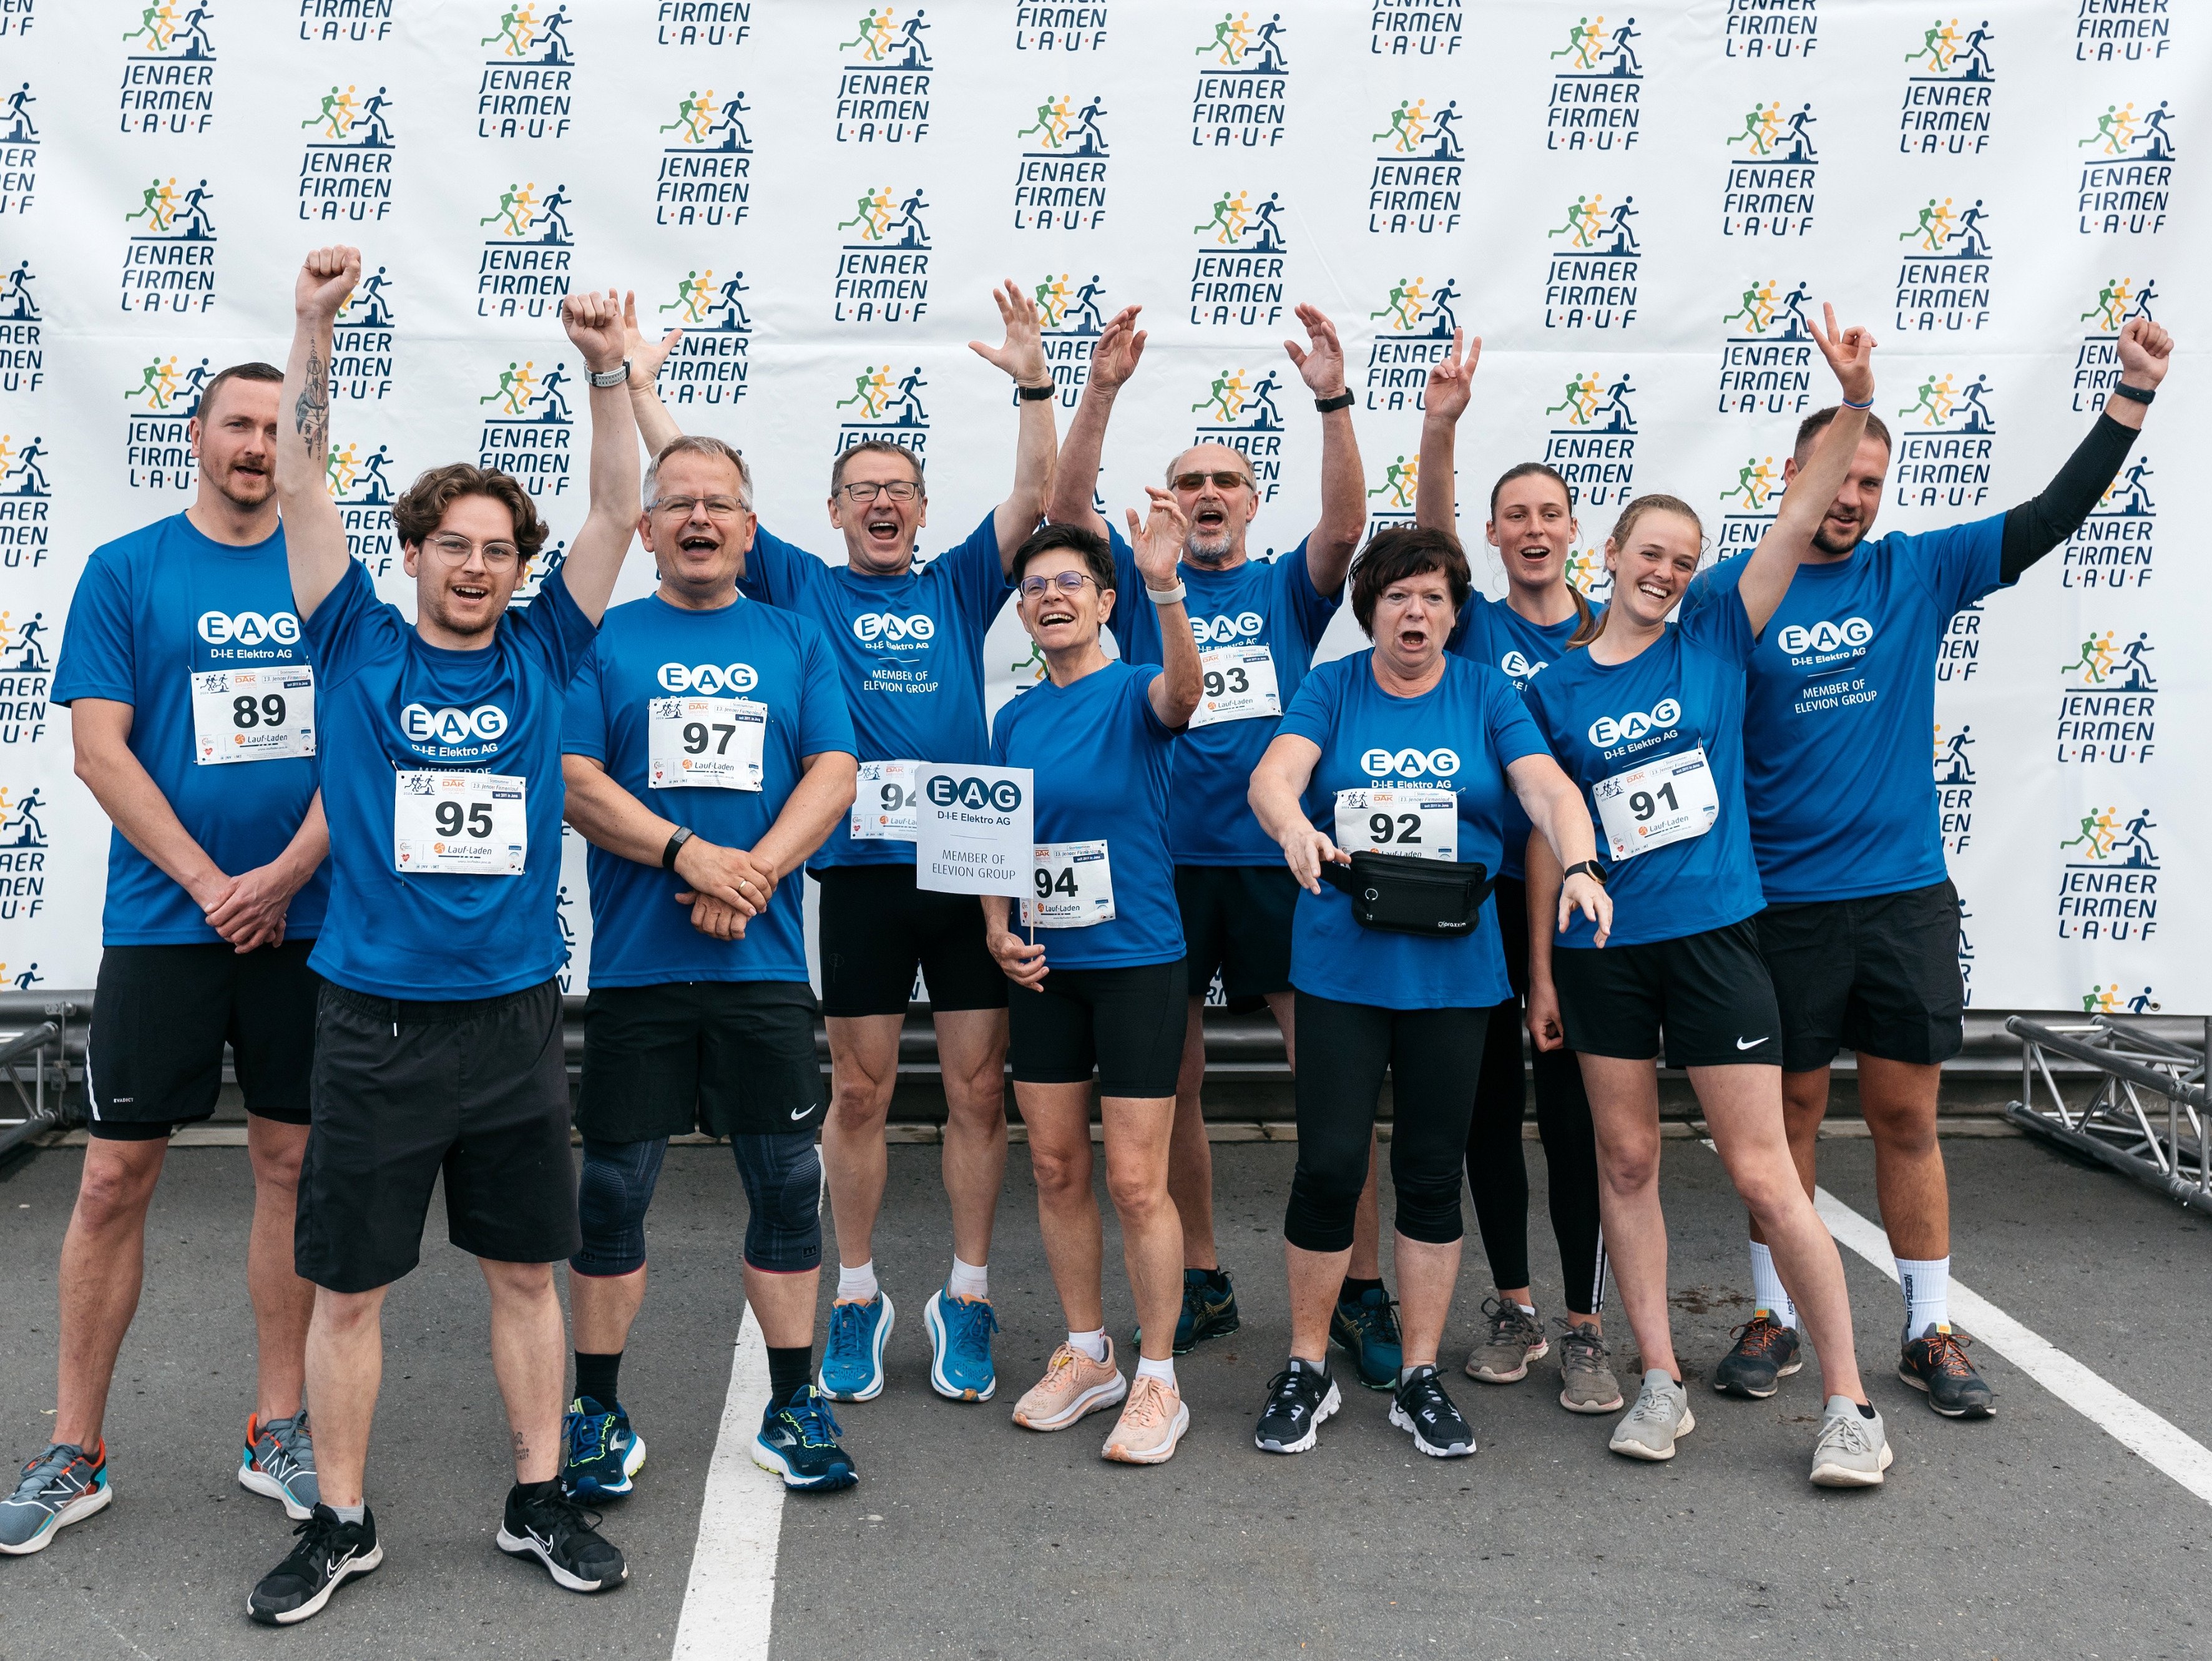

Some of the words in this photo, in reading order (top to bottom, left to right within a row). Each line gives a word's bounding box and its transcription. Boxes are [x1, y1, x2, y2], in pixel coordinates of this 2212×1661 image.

[300, 0, 393, 18] FIRMEN
[658, 2, 751, 22] FIRMEN
[1016, 7, 1107, 29] FIRMEN
[1371, 11, 1462, 32] FIRMEN
[1726, 15, 1818, 35] FIRMEN
[2077, 18, 2169, 38] FIRMEN
[120, 65, 213, 89] JENAER
[478, 70, 571, 94] JENAER
[837, 75, 930, 99] JENAER
[120, 90, 213, 110] FIRMEN
[1193, 79, 1285, 103] JENAER
[1548, 83, 1640, 107] JENAER
[1902, 86, 1992, 110] JENAER
[478, 95, 571, 115] FIRMEN
[836, 99, 929, 120] FIRMEN
[1193, 104, 1285, 124] FIRMEN
[1548, 108, 1640, 127] FIRMEN
[1901, 110, 1990, 131] FIRMEN
[300, 152, 392, 177] JENAER
[657, 157, 750, 182] JENAER
[1015, 162, 1107, 186] JENAER
[299, 177, 392, 198] FIRMEN
[1369, 166, 1462, 190] JENAER
[1725, 169, 1815, 193] JENAER
[2078, 166, 2171, 193] JENAER
[657, 182, 750, 203] FIRMEN
[1015, 187, 1106, 207] FIRMEN
[1369, 190, 1461, 210] FIRMEN
[2079, 191, 2169, 212] FIRMEN
[1723, 194, 1814, 213] FIRMEN
[123, 245, 214, 268] JENAER
[835, 254, 928, 278] JENAER
[122, 270, 215, 290] FIRMEN
[1191, 258, 1283, 282] JENAER
[1546, 261, 1638, 285] JENAER
[1896, 265, 1989, 288] JENAER
[835, 279, 928, 299] FIRMEN
[1191, 282, 1283, 303] FIRMEN
[1545, 286, 1637, 306] FIRMEN
[1896, 289, 1989, 308] FIRMEN
[1720, 346, 1811, 370] JENAER
[1720, 371, 1810, 391] FIRMEN
[1897, 439, 1992, 464] JENAER
[1897, 464, 1990, 484] FIRMEN
[2063, 546, 2153, 566] FIRMEN
[205, 615, 297, 640] EAG
[859, 615, 931, 638] EAG
[1190, 614, 1261, 640] EAG
[1784, 620, 1869, 651] EAG
[210, 649, 234, 659] D-I-E
[237, 649, 275, 659] Elektro
[276, 649, 292, 659] AG
[865, 641, 884, 650] D-I-E
[886, 640, 914, 650] Elektro
[1791, 657, 1813, 666] D-I-E
[1816, 652, 1849, 664] Elektro
[1852, 647, 1866, 657] AG
[664, 666, 753, 690] EAG
[872, 670, 913, 681] MEMBER
[915, 671, 927, 681] OF
[1204, 667, 1250, 697] 93
[864, 680, 903, 692] ELEVION
[906, 682, 938, 693] GROUP
[1803, 682, 1849, 698] MEMBER
[1852, 679, 1865, 690] OF
[233, 694, 286, 728] 89
[1218, 698, 1253, 708] Lauf-Laden
[1794, 697, 1838, 714] ELEVION
[1841, 690, 1877, 705] GROUP
[2058, 697, 2155, 720] JENAER
[407, 708, 502, 738] EAG
[1593, 701, 1676, 745] EAG
[2057, 721, 2155, 741] FIRMEN
[248, 734, 288, 743] Lauf-Laden
[683, 722, 736, 755] 97
[1603, 747, 1626, 760] D-I-E
[1627, 737, 1661, 753] Elektro
[1663, 730, 1678, 741] AG
[411, 743, 436, 755] D-I-E
[439, 746, 478, 757] Elektro
[481, 743, 498, 753] AG
[695, 762, 734, 771] Lauf-Laden
[1368, 752, 1456, 773] EAG
[932, 778, 1017, 810] EAG
[1371, 780, 1394, 788] D-I-E
[1397, 780, 1433, 788] Elektro
[1436, 780, 1451, 788] AG
[1629, 782, 1679, 821] 91
[435, 801, 492, 838] 95
[937, 811, 958, 820] D-I-E
[961, 813, 993, 824] Elektro
[996, 816, 1011, 825] AG
[1369, 813, 1422, 844] 92
[1649, 815, 1689, 832] Lauf-Laden
[448, 846, 492, 855] Lauf-Laden
[942, 850, 987, 863] MEMBER
[992, 854, 1006, 865] OF
[932, 863, 974, 877] ELEVION
[978, 868, 1015, 880] GROUP
[1035, 867, 1079, 898] 94
[2058, 873, 2157, 896] JENAER
[2058, 897, 2157, 919] FIRMEN
